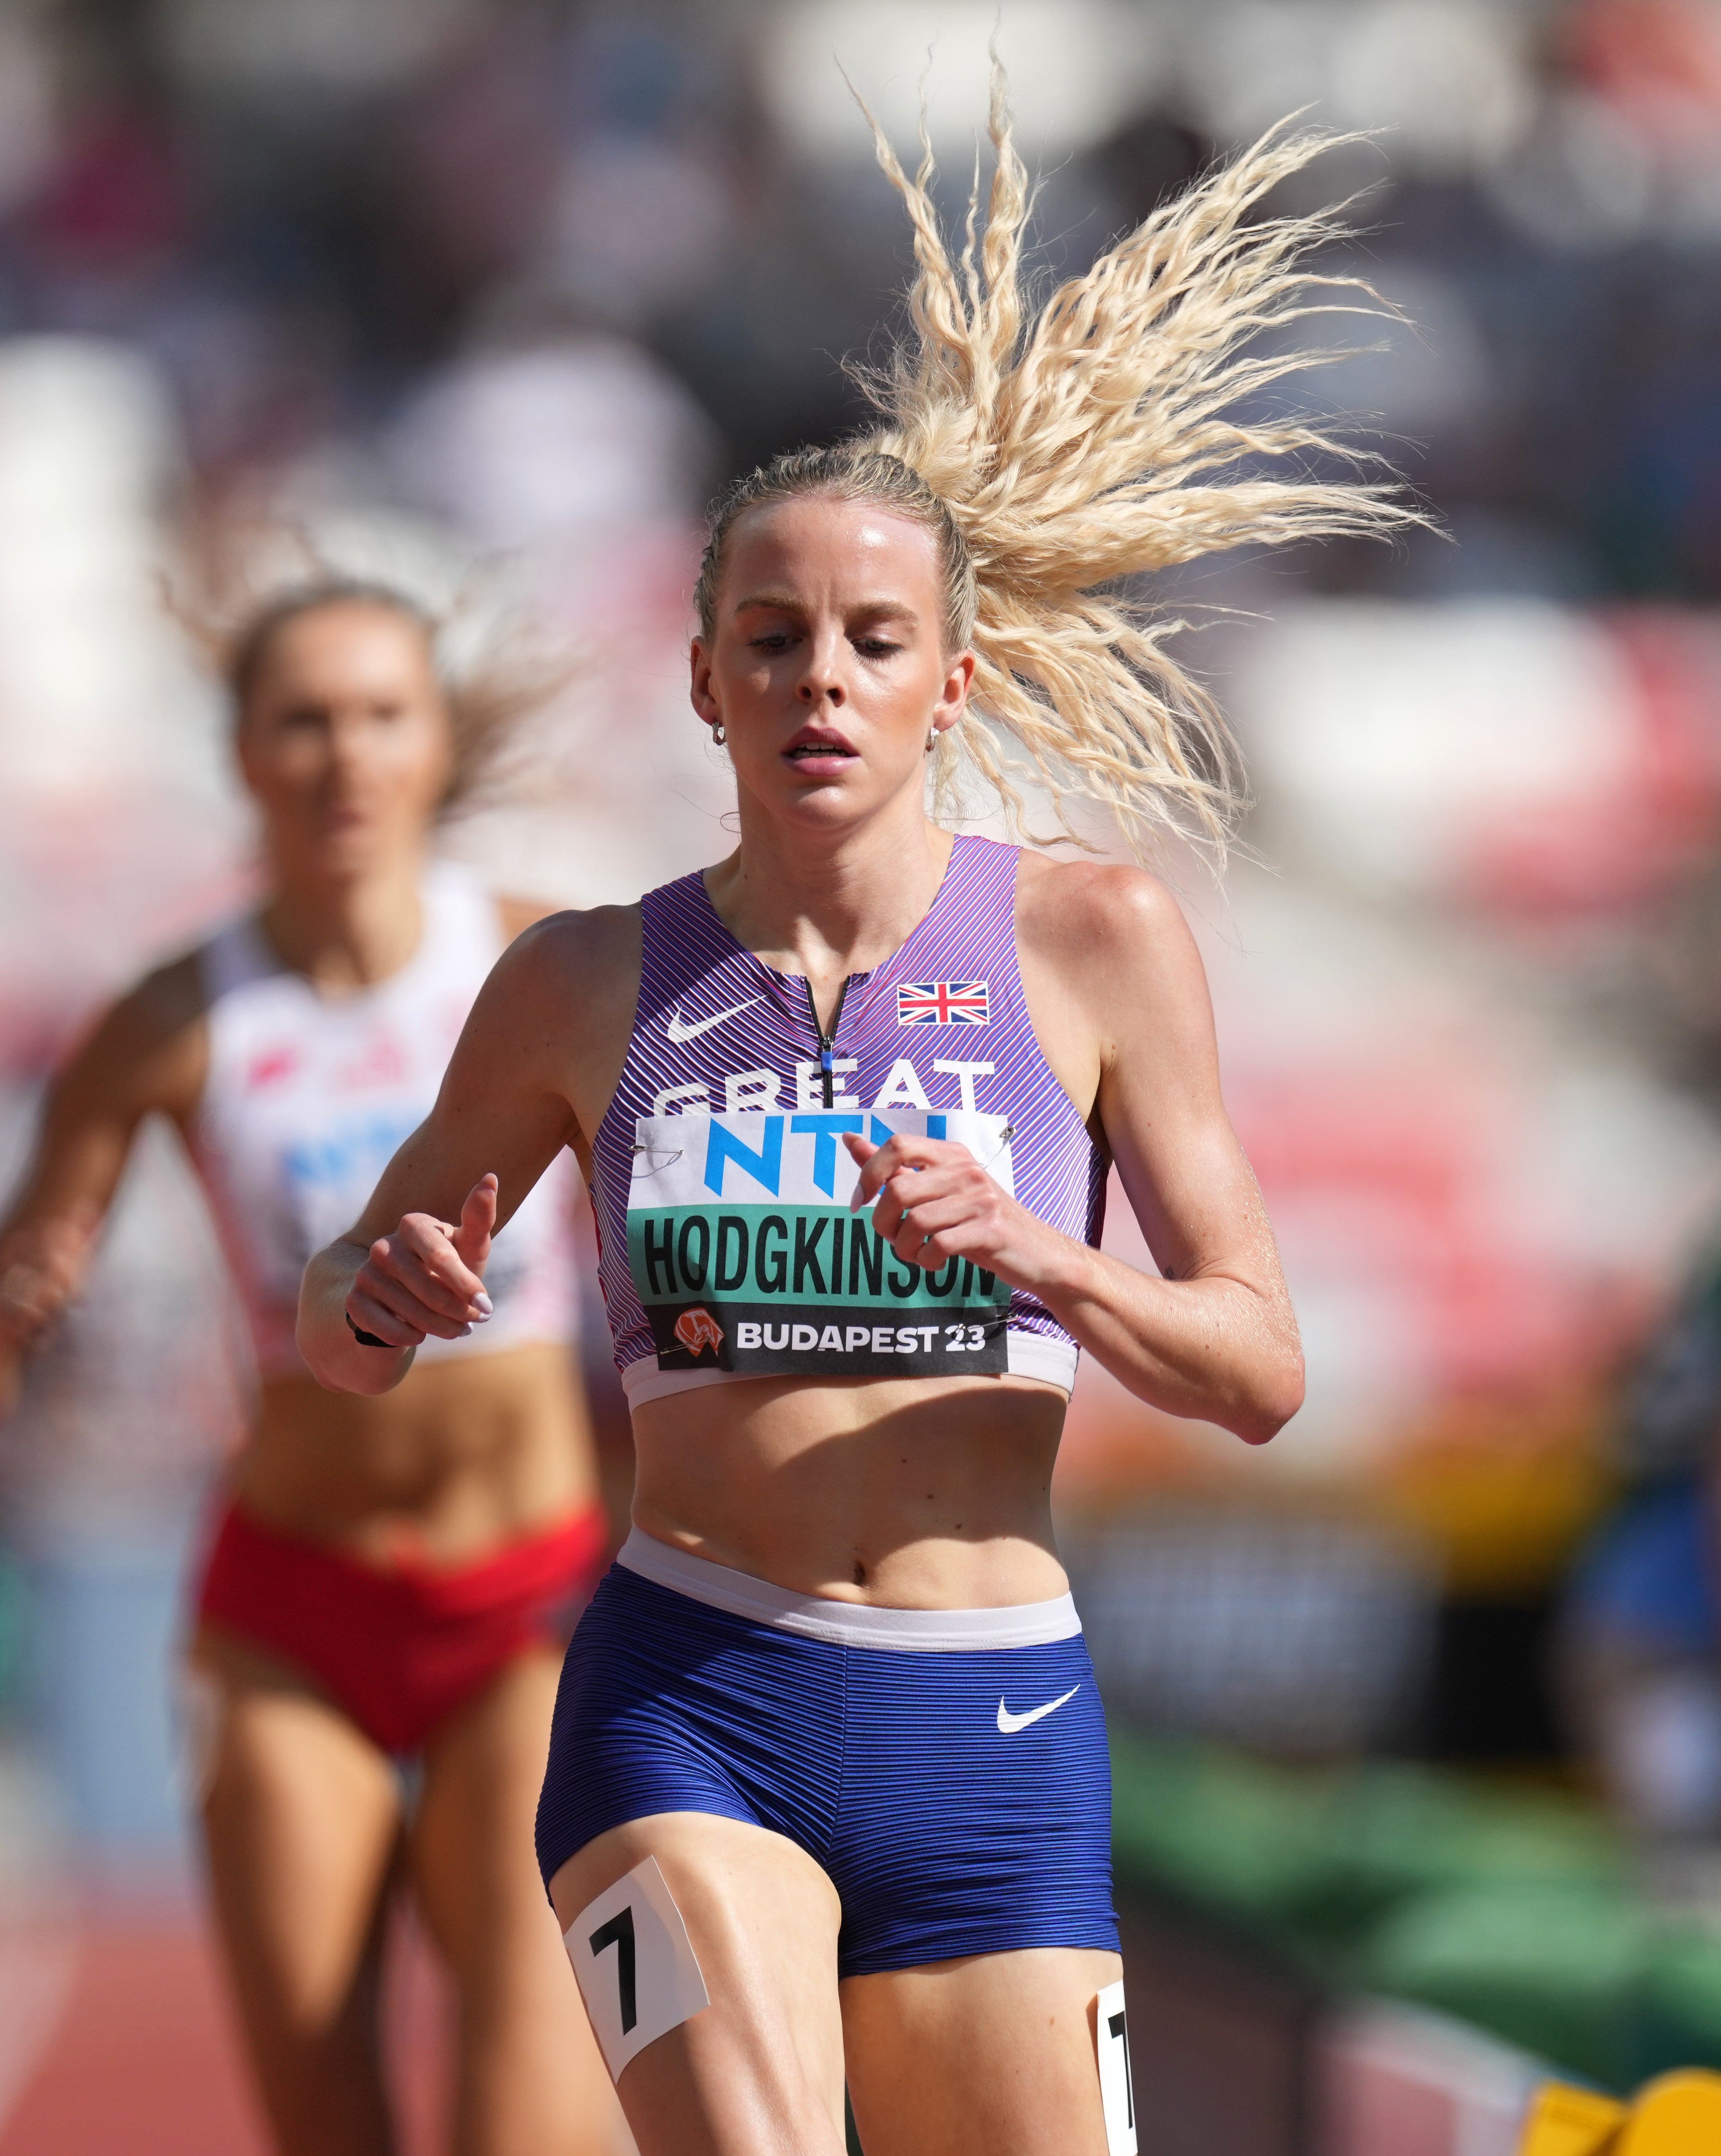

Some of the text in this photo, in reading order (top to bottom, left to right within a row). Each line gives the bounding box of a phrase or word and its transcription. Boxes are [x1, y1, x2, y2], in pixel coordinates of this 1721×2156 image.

[654, 1058, 995, 1116] GREAT
[737, 1322, 986, 1354] BUDAPEST 23
